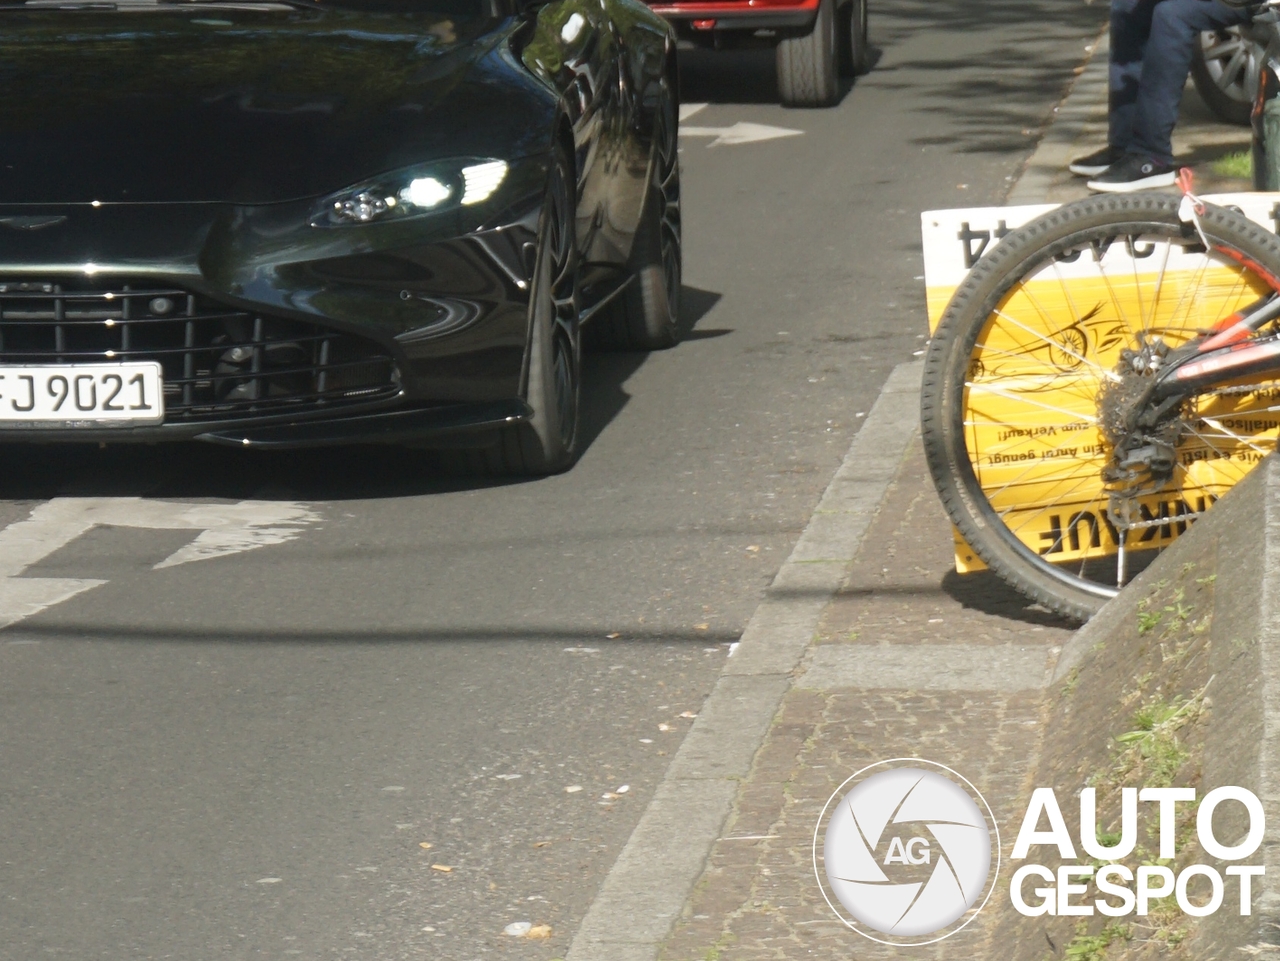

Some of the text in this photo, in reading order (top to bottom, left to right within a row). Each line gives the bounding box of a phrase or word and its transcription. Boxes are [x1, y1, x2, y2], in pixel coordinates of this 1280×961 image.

[47, 373, 152, 412] 9021
[998, 426, 1057, 441] Verkauf!
[988, 444, 1105, 466] Ein Anruf genügt
